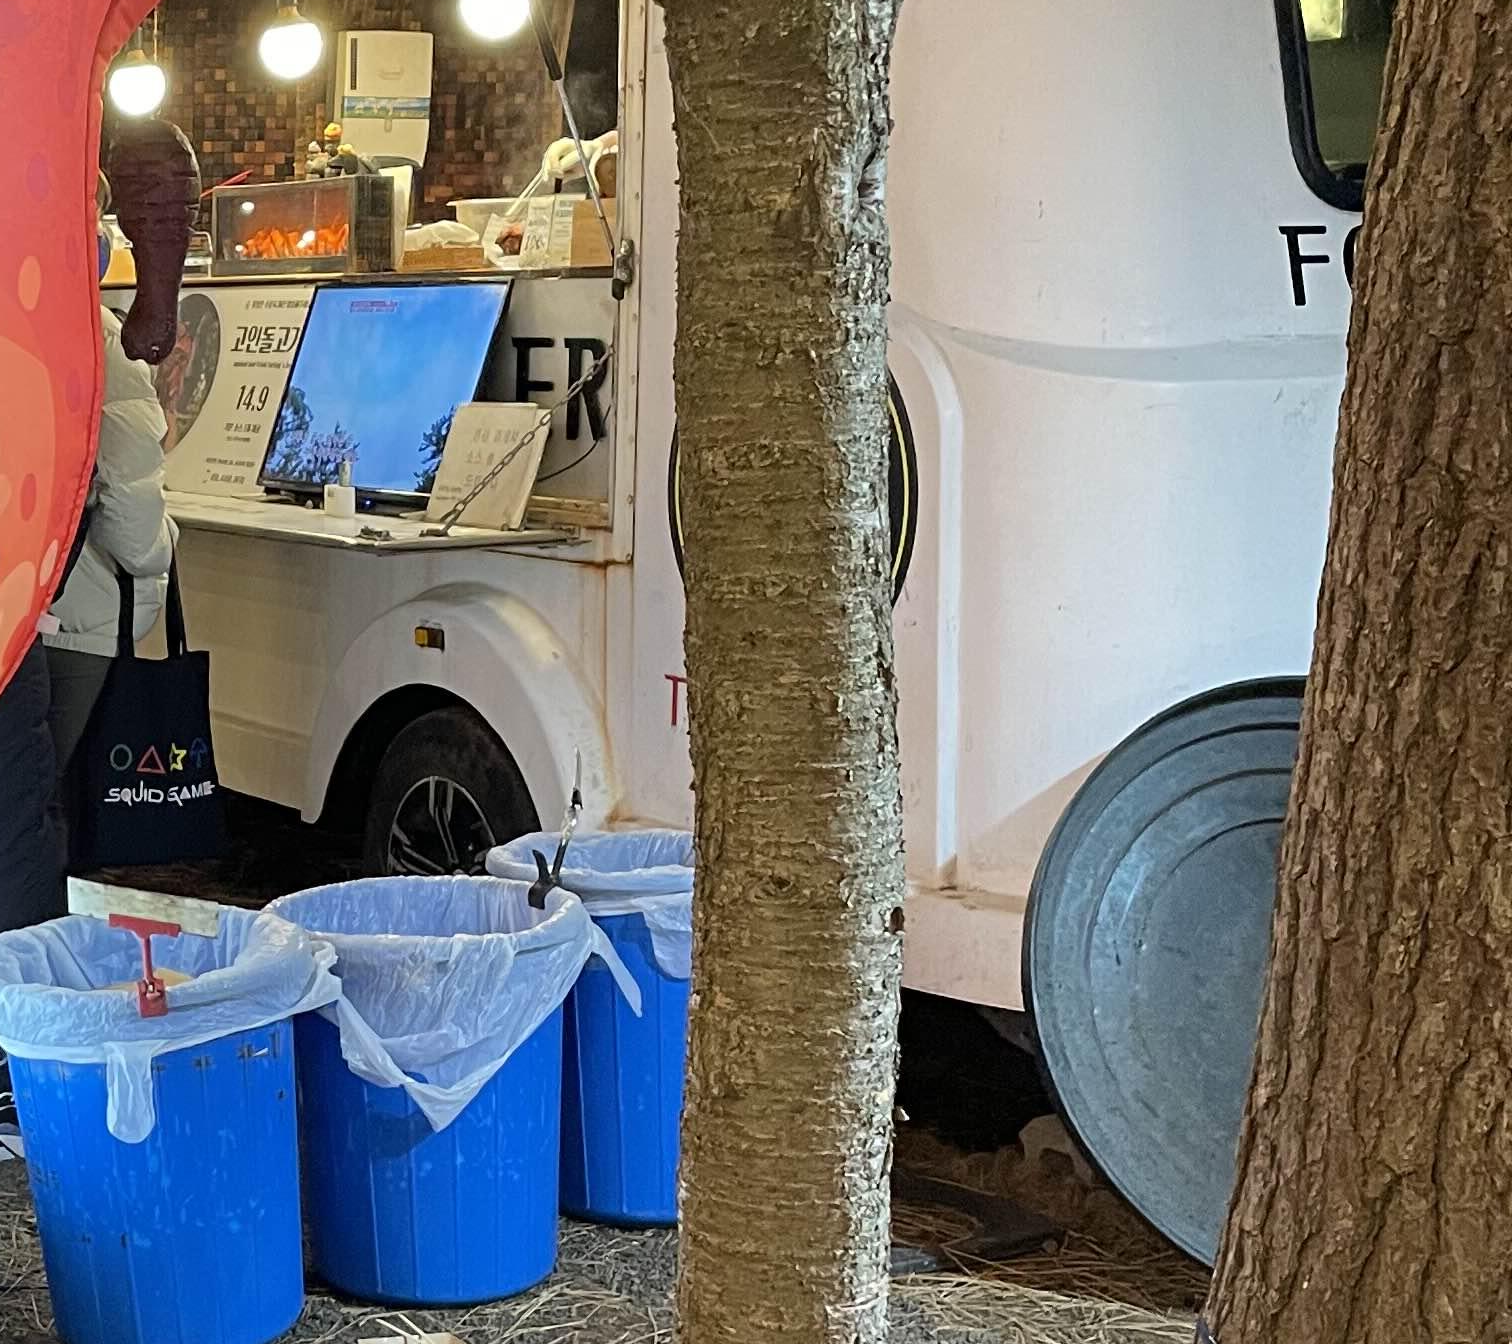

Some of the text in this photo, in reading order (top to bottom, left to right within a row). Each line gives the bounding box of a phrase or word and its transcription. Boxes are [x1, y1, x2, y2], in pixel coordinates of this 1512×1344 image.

[1278, 225, 1364, 306] F
[104, 780, 216, 807] SQUID GAME
